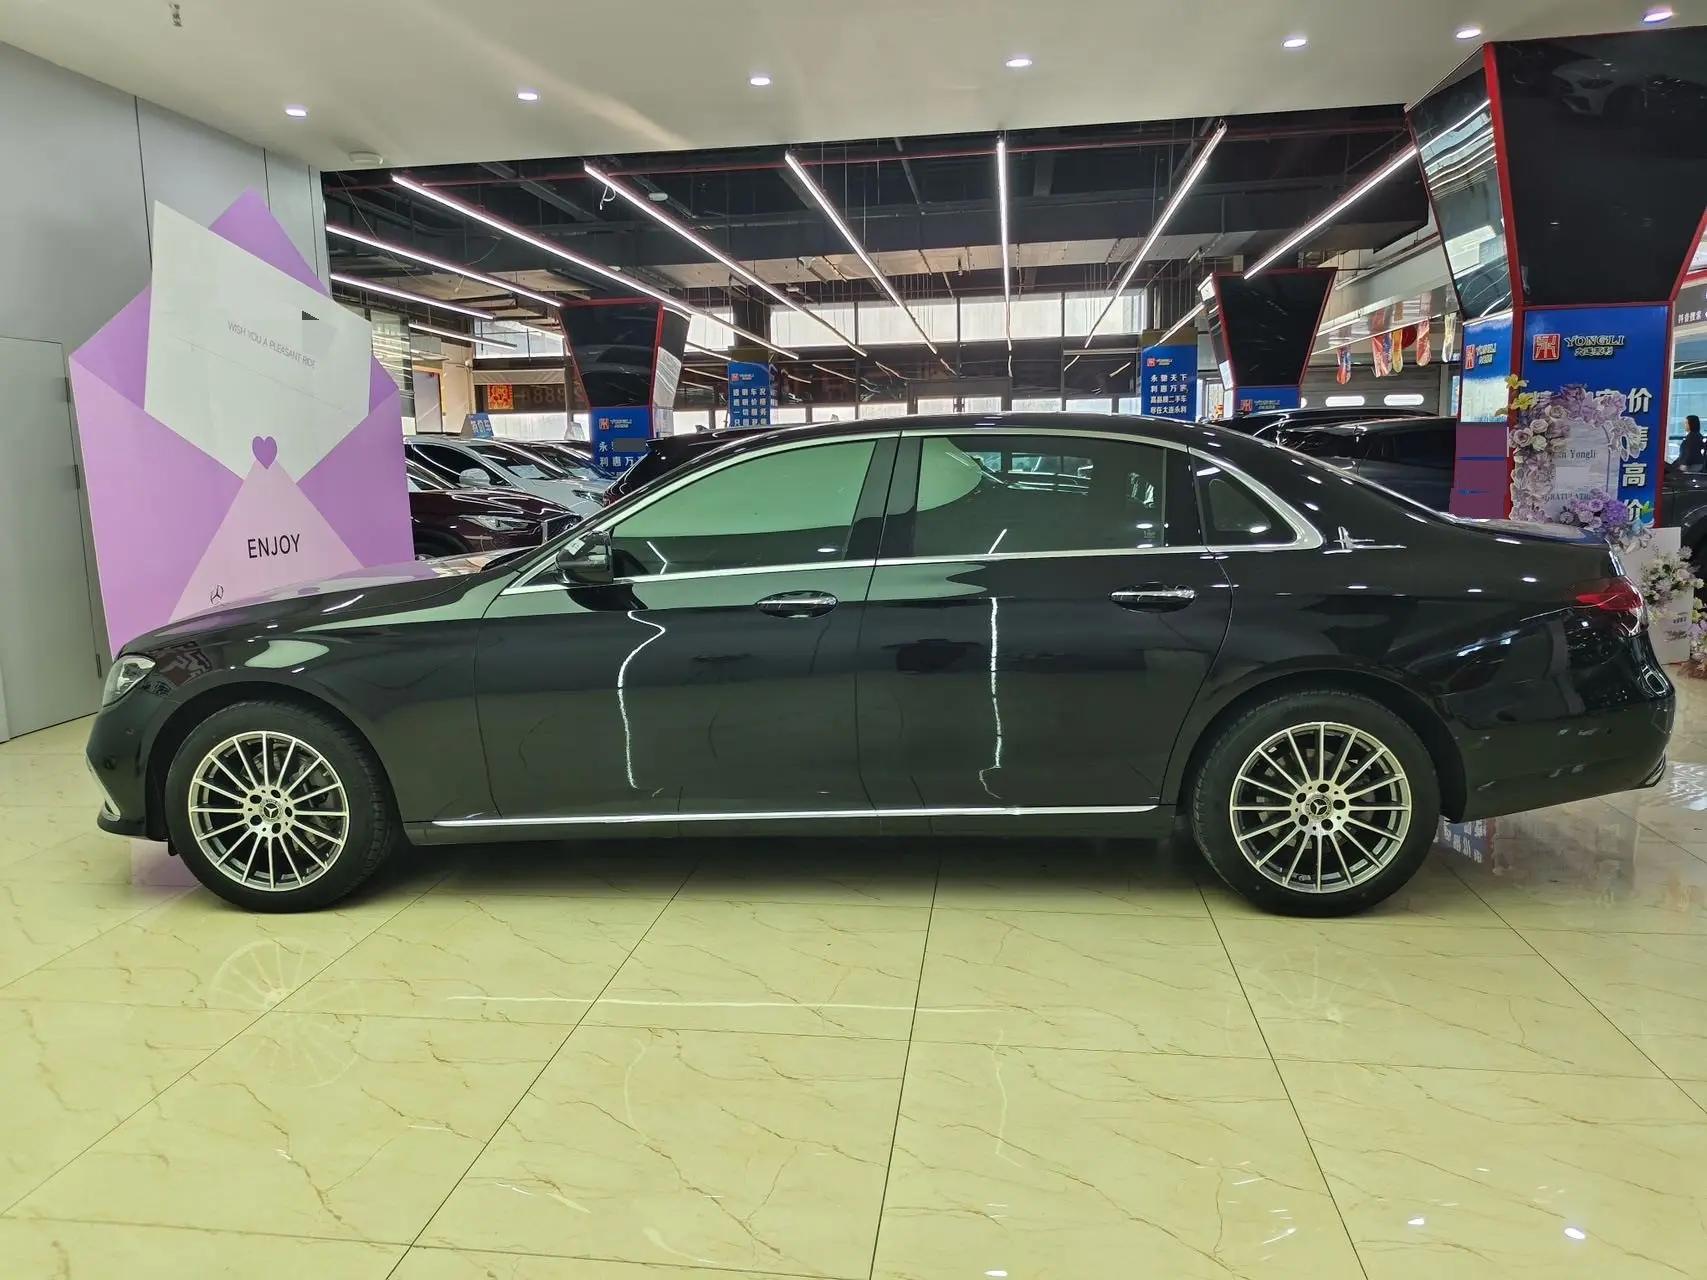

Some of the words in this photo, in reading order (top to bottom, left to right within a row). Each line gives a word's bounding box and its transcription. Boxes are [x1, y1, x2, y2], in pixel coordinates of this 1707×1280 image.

[227, 319, 246, 335] WISH
[247, 329, 262, 344] YOU
[268, 340, 302, 362] PLEASANT
[1564, 335, 1624, 348] YONGLI
[1569, 448, 1597, 460] Yongli
[247, 533, 300, 559] ENJOY
